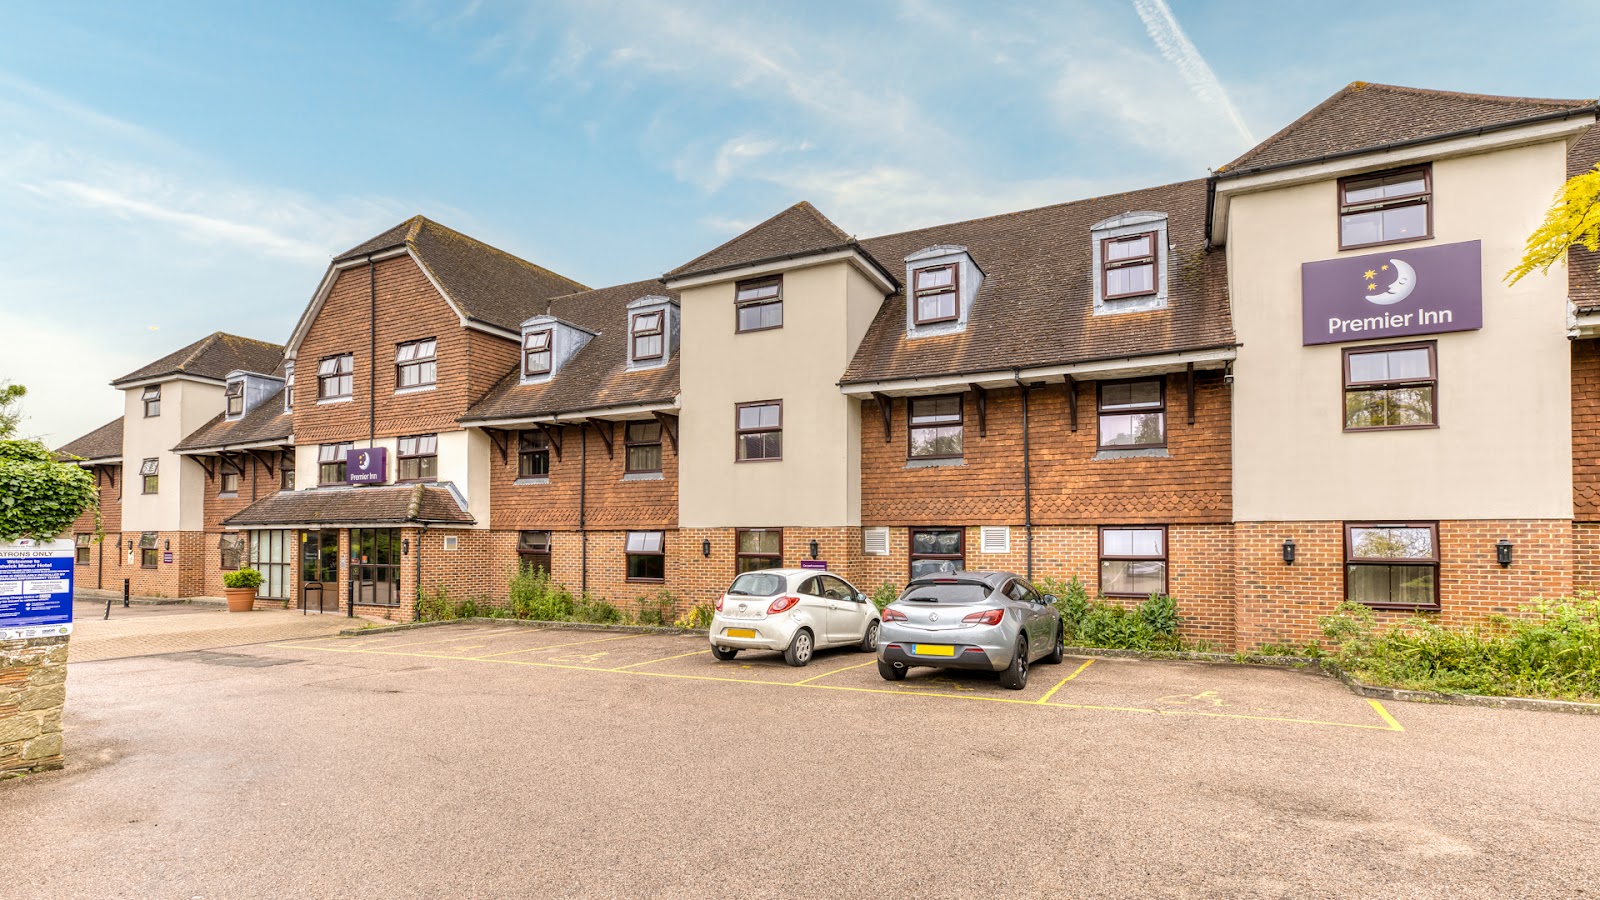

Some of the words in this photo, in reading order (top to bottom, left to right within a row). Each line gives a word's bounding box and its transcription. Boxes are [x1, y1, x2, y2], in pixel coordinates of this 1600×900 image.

[1328, 312, 1414, 334] Premier
[1418, 308, 1453, 325] Inn
[350, 473, 369, 481] Premier
